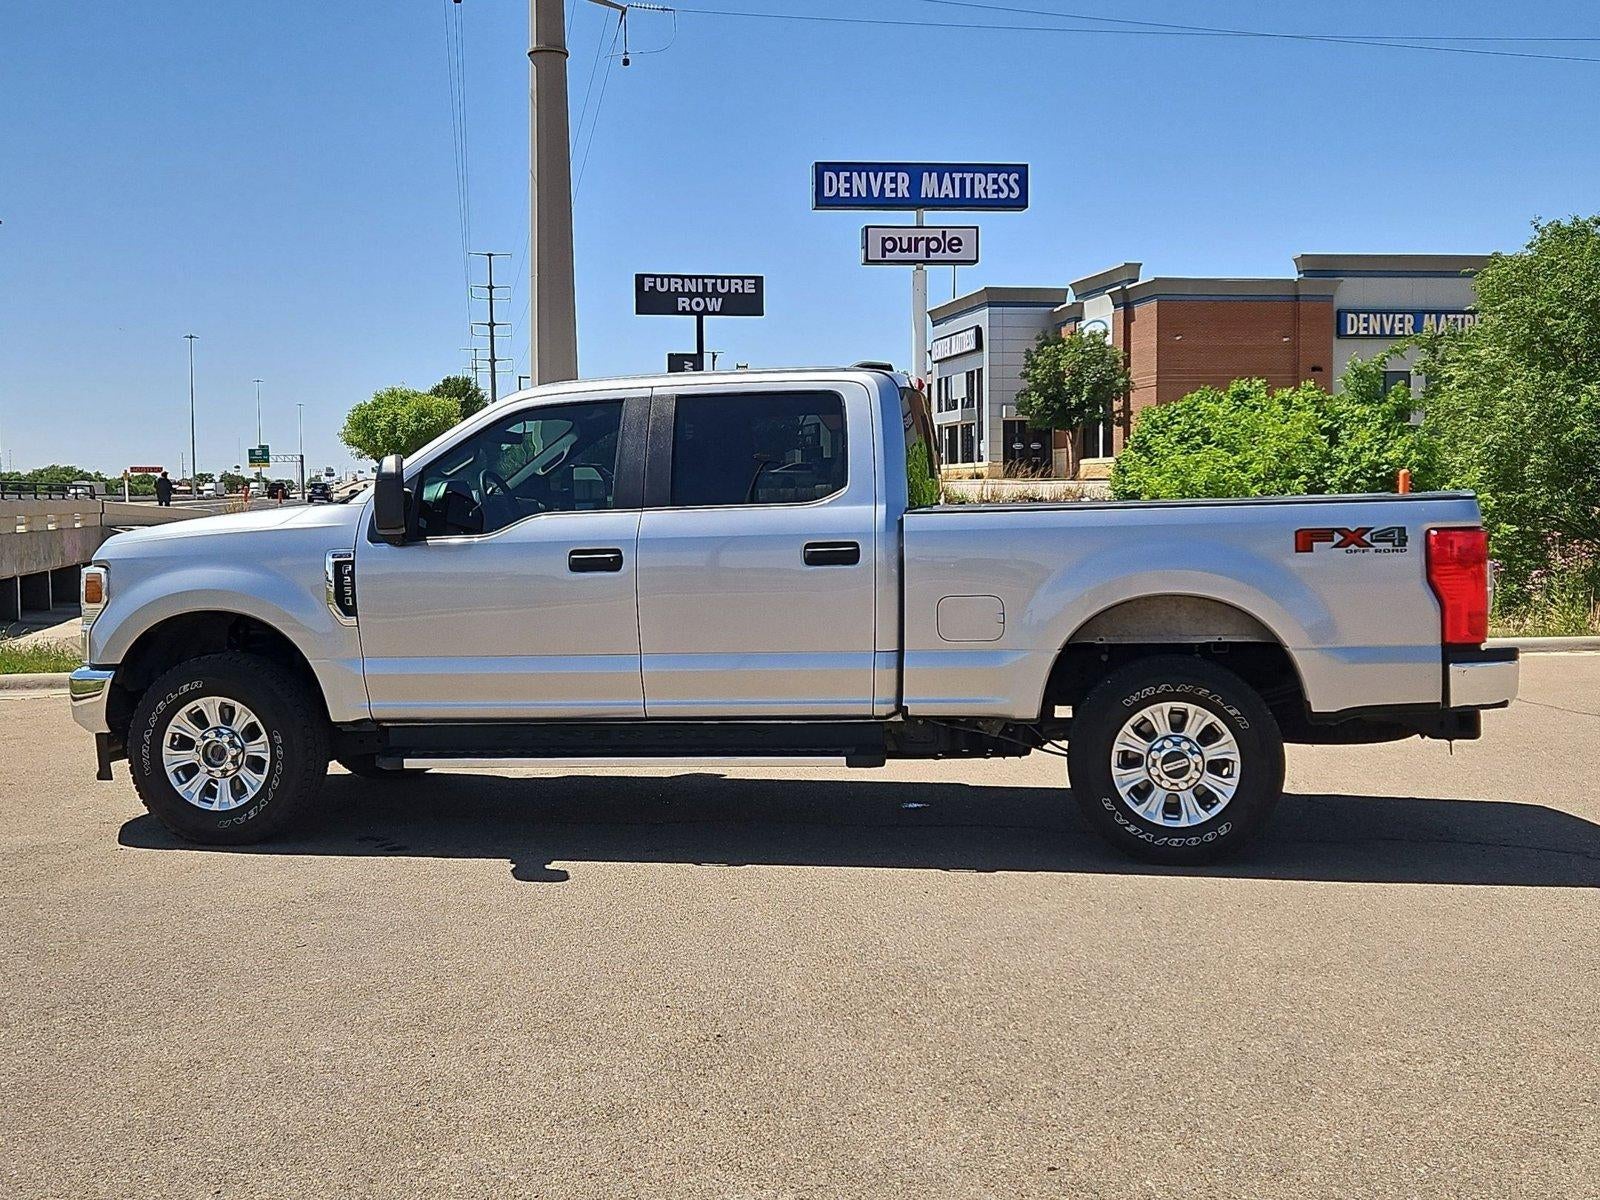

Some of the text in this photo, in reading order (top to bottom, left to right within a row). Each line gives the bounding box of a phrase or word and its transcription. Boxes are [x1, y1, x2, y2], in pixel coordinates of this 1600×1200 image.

[823, 171, 1020, 199] DENVER MATTRESS
[880, 230, 963, 258] purple
[643, 277, 756, 293] FURNITURE
[677, 297, 723, 312] ROW
[1346, 313, 1414, 335] DENVER
[1294, 526, 1408, 553] FX4
[341, 564, 353, 606] F250
[1122, 683, 1250, 730] WRANGLER
[141, 680, 204, 776] WRANGLER
[217, 730, 284, 829] GOODYEAR
[1101, 797, 1232, 847] GOODYEAR
